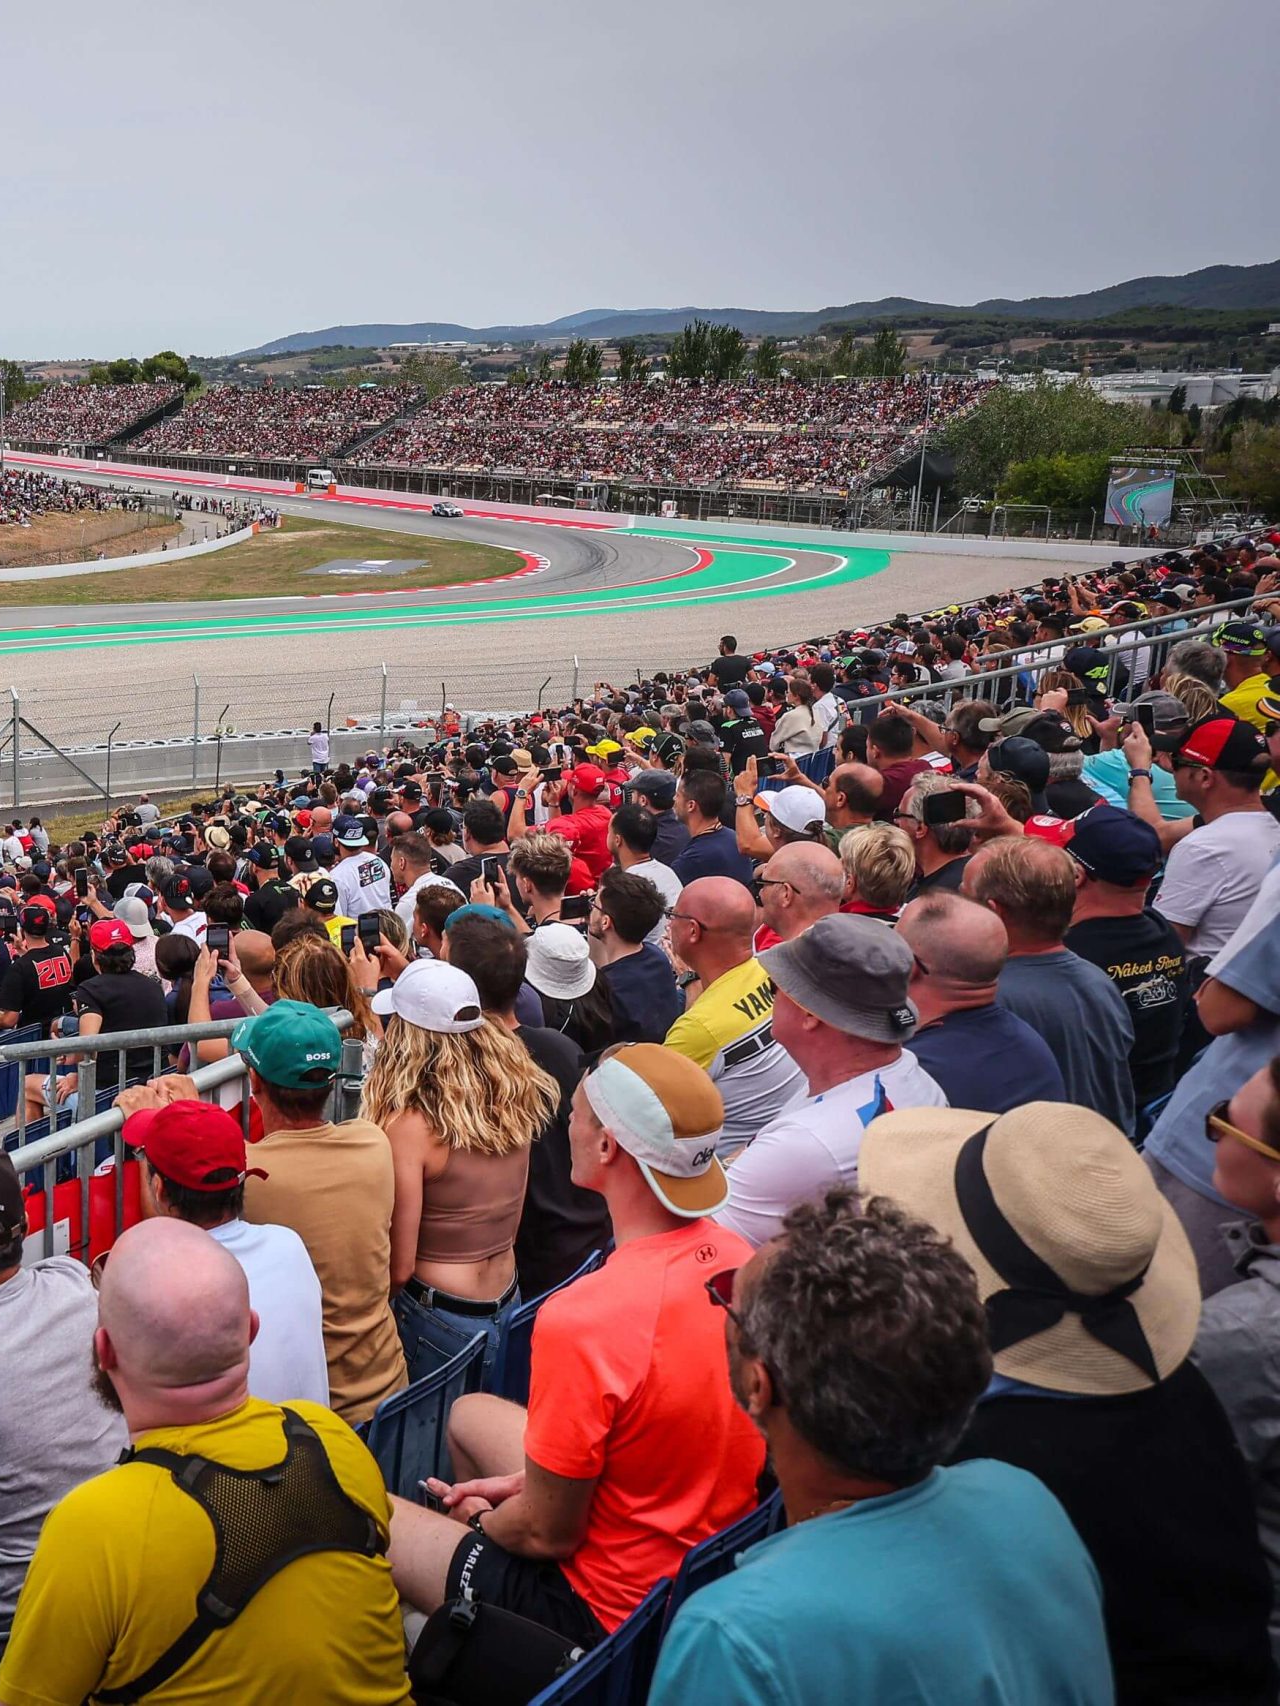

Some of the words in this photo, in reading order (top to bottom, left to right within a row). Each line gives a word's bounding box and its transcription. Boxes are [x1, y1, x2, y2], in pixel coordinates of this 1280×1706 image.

[32, 953, 72, 989] 20
[1107, 960, 1153, 980] Naked
[305, 1052, 331, 1062] BOSS
